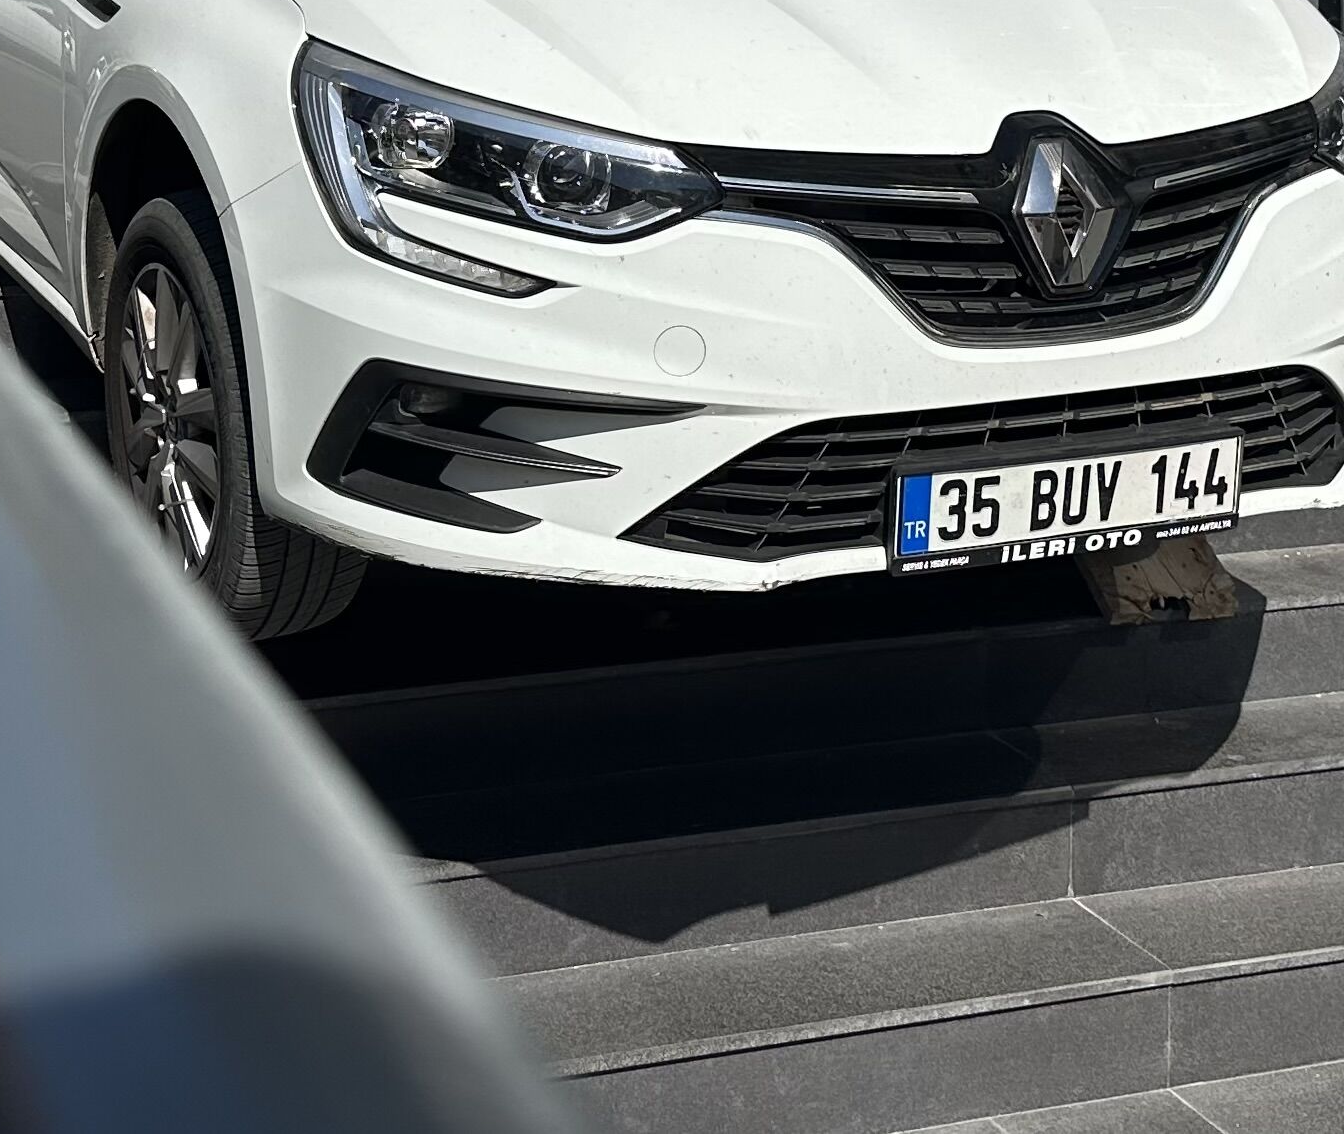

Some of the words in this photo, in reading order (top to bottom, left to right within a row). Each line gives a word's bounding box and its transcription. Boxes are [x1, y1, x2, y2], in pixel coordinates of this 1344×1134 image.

[937, 475, 1001, 542] 35
[1030, 460, 1122, 532] BUV
[1151, 447, 1228, 514] 144
[904, 521, 928, 540] TR
[1086, 529, 1142, 553] OTO
